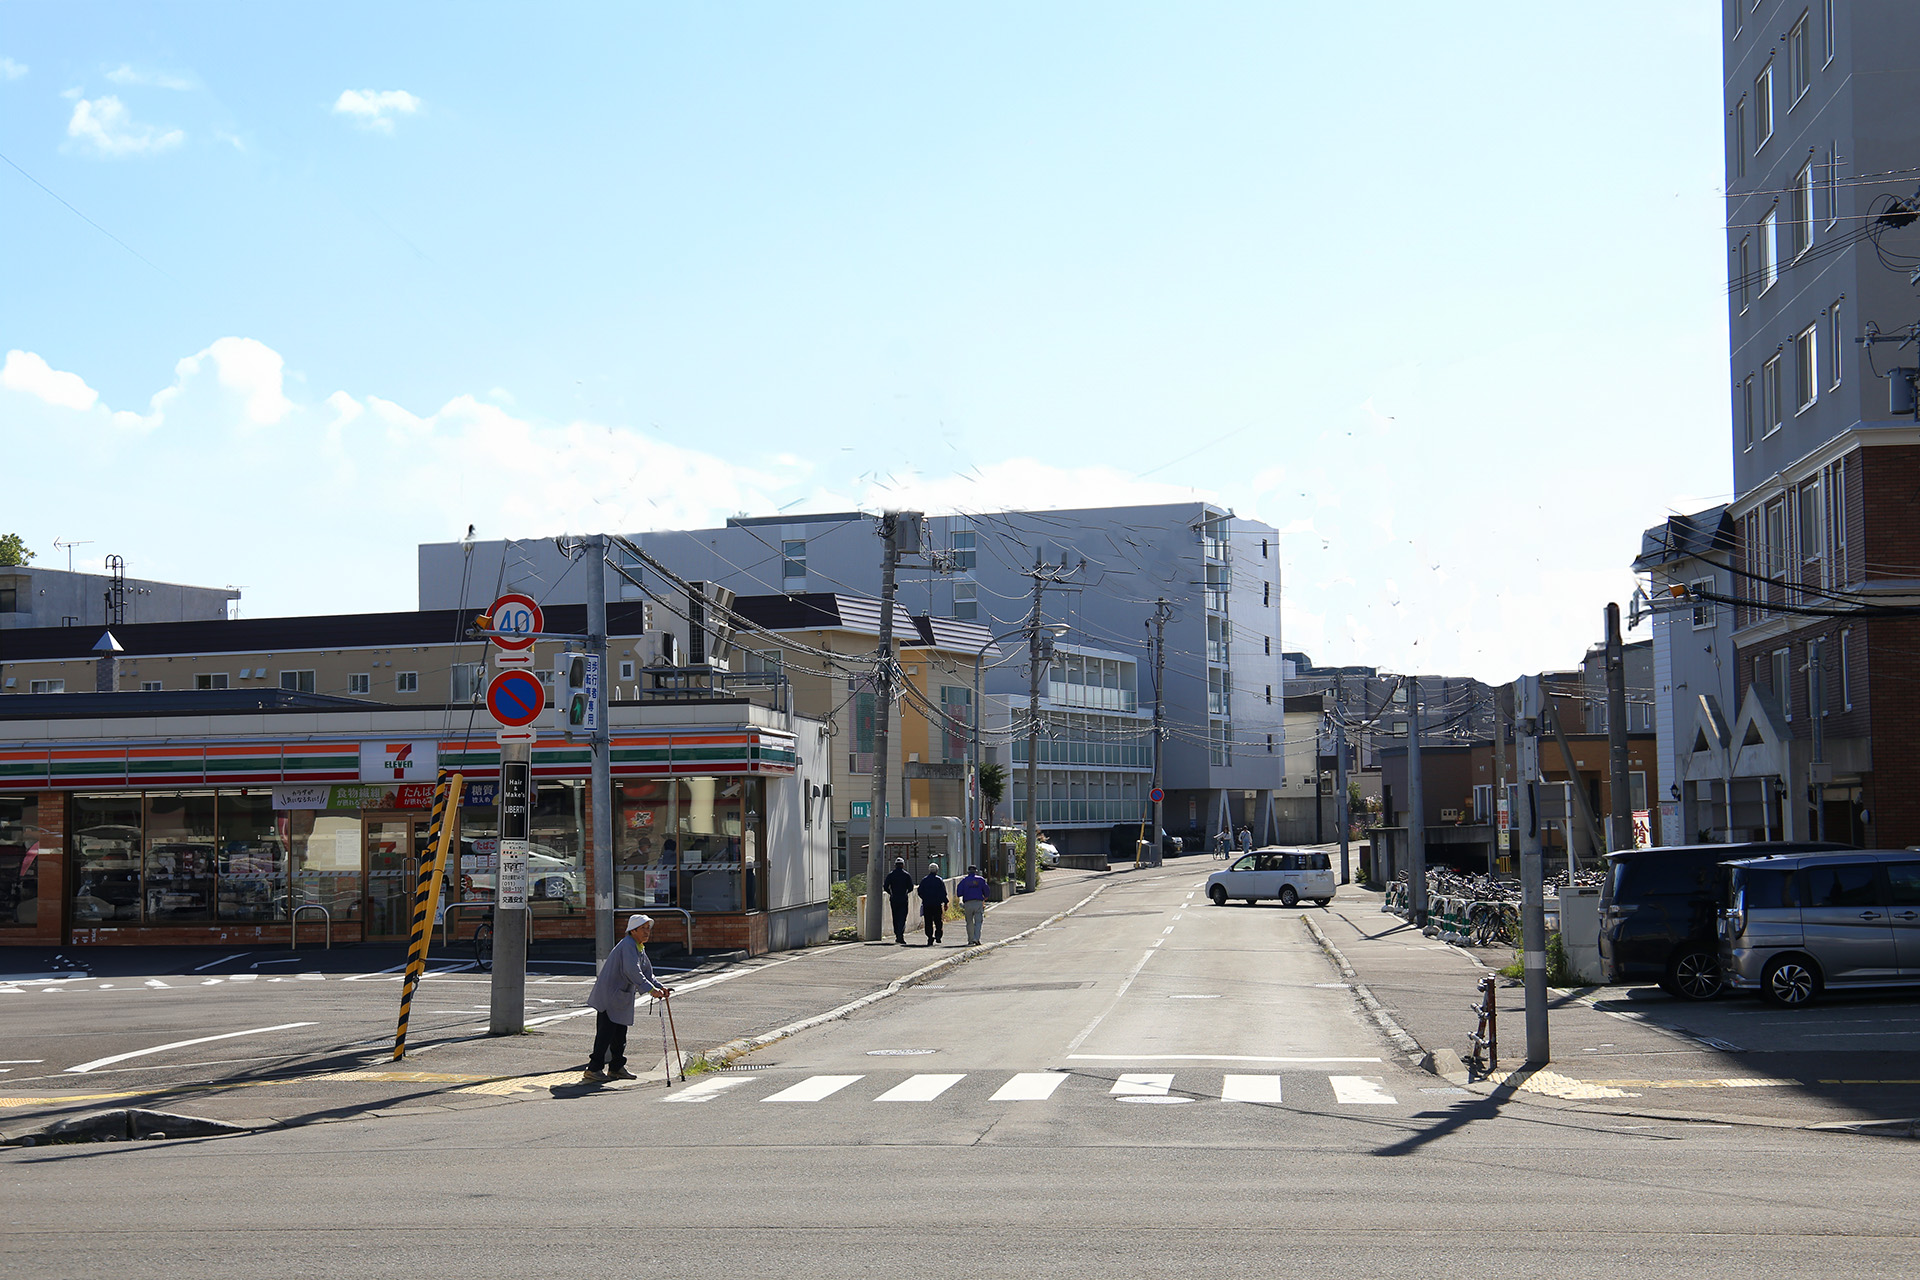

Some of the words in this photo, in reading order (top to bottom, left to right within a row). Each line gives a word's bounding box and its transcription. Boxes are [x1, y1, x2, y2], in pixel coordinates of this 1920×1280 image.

[499, 610, 529, 633] 40
[588, 700, 595, 726] 専用
[471, 785, 493, 796] 糖質
[505, 806, 526, 814] LIBERTY
[476, 841, 496, 850] たばこ
[502, 896, 524, 904] 交通安全
